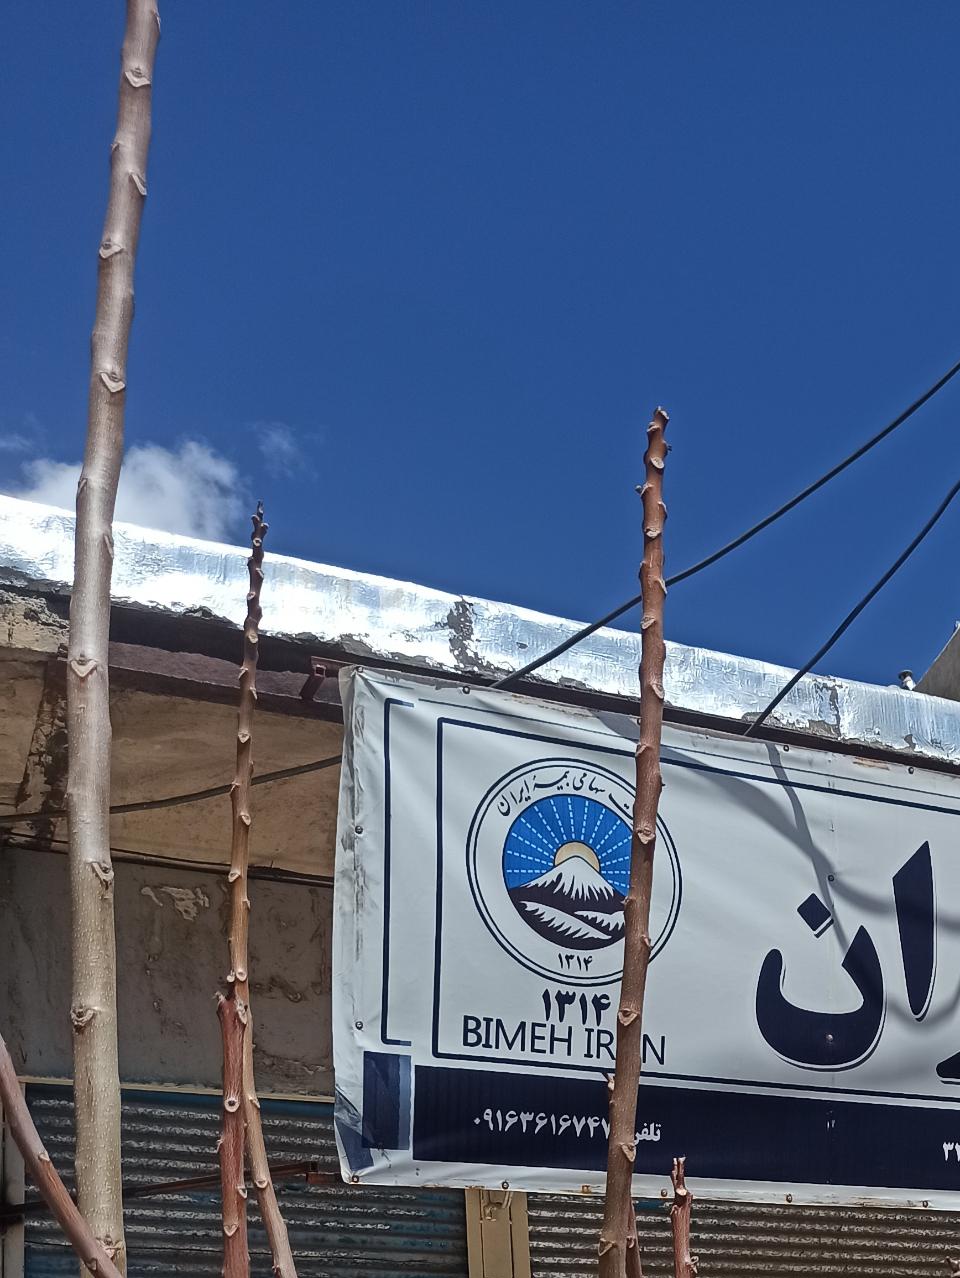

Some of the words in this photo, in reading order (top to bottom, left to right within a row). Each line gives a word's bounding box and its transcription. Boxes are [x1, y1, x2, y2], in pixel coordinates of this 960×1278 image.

[497, 779, 532, 817] ایران
[557, 953, 593, 972] ۱۳۱۴
[541, 988, 612, 1027] ۱۳۱۴
[462, 1014, 573, 1057] BIMEH
[584, 1027, 667, 1066] IRN
